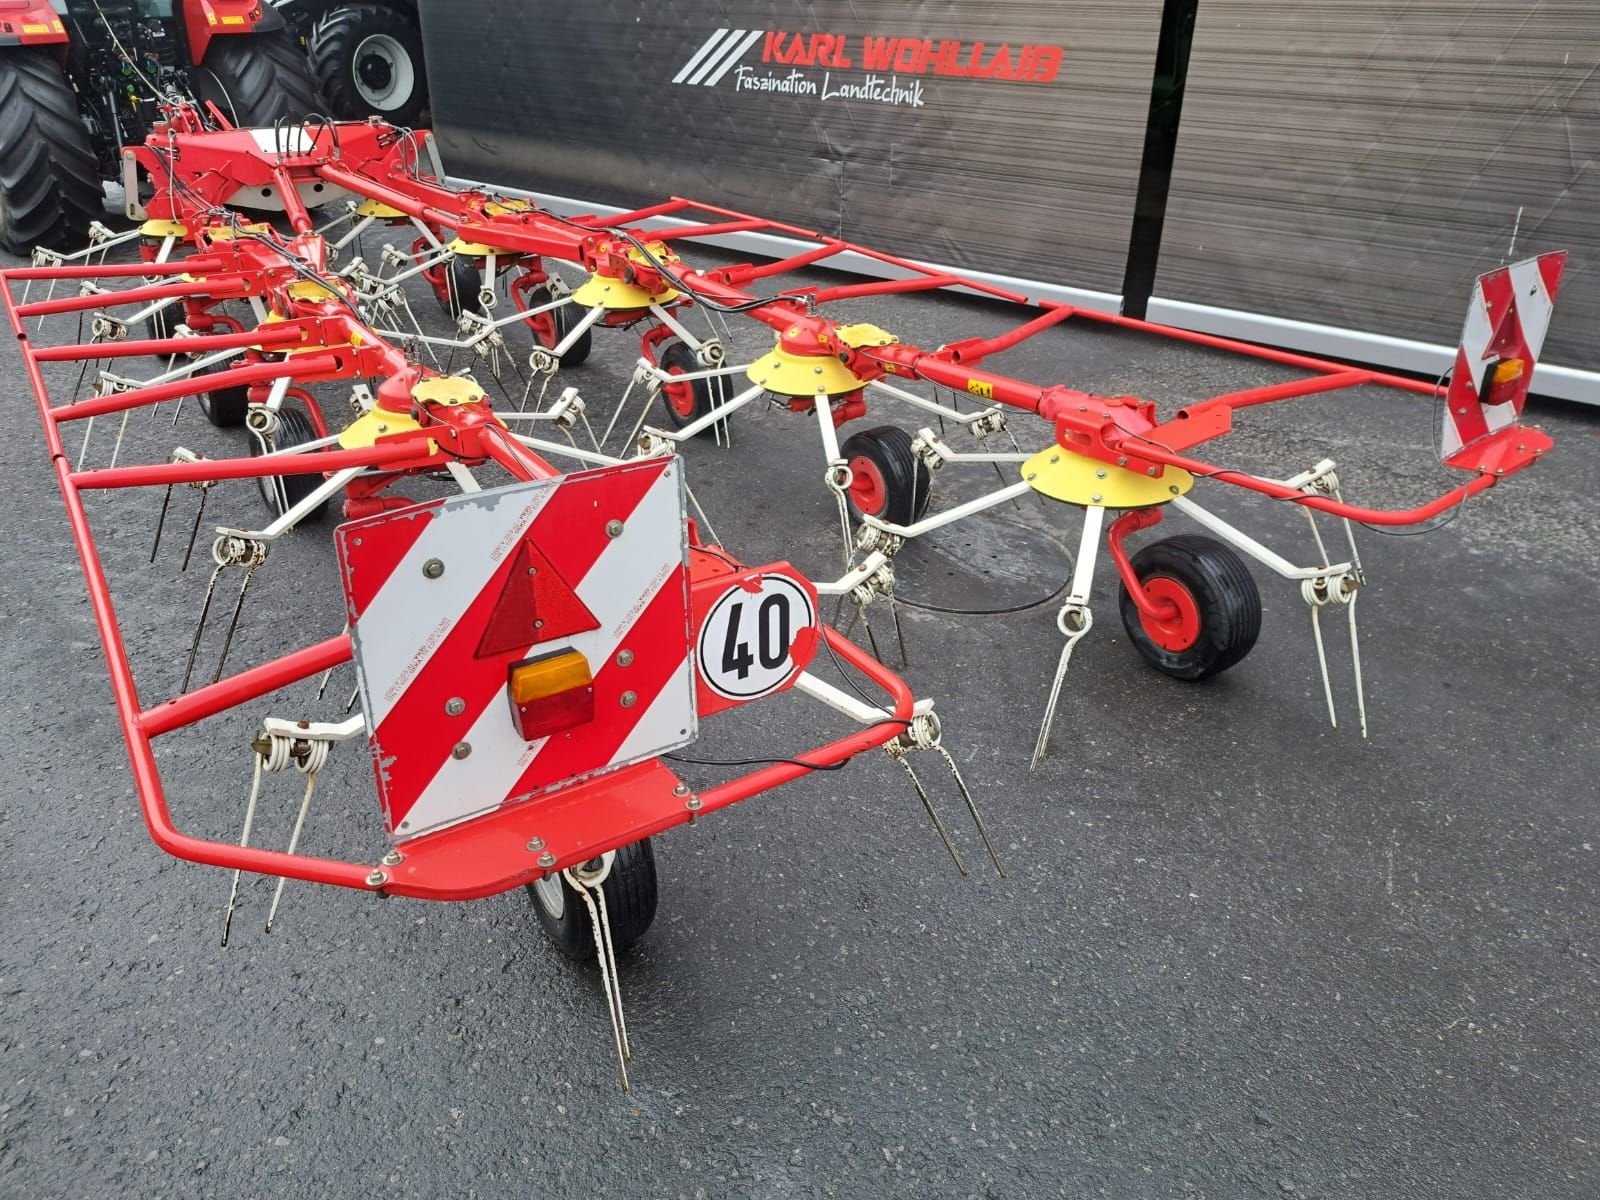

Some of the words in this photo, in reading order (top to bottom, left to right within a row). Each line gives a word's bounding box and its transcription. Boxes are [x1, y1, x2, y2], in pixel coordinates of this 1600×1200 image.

[761, 31, 852, 69] KARL
[734, 64, 817, 95] Faszination
[821, 71, 925, 107] Landtechnik
[721, 593, 790, 680] 40
